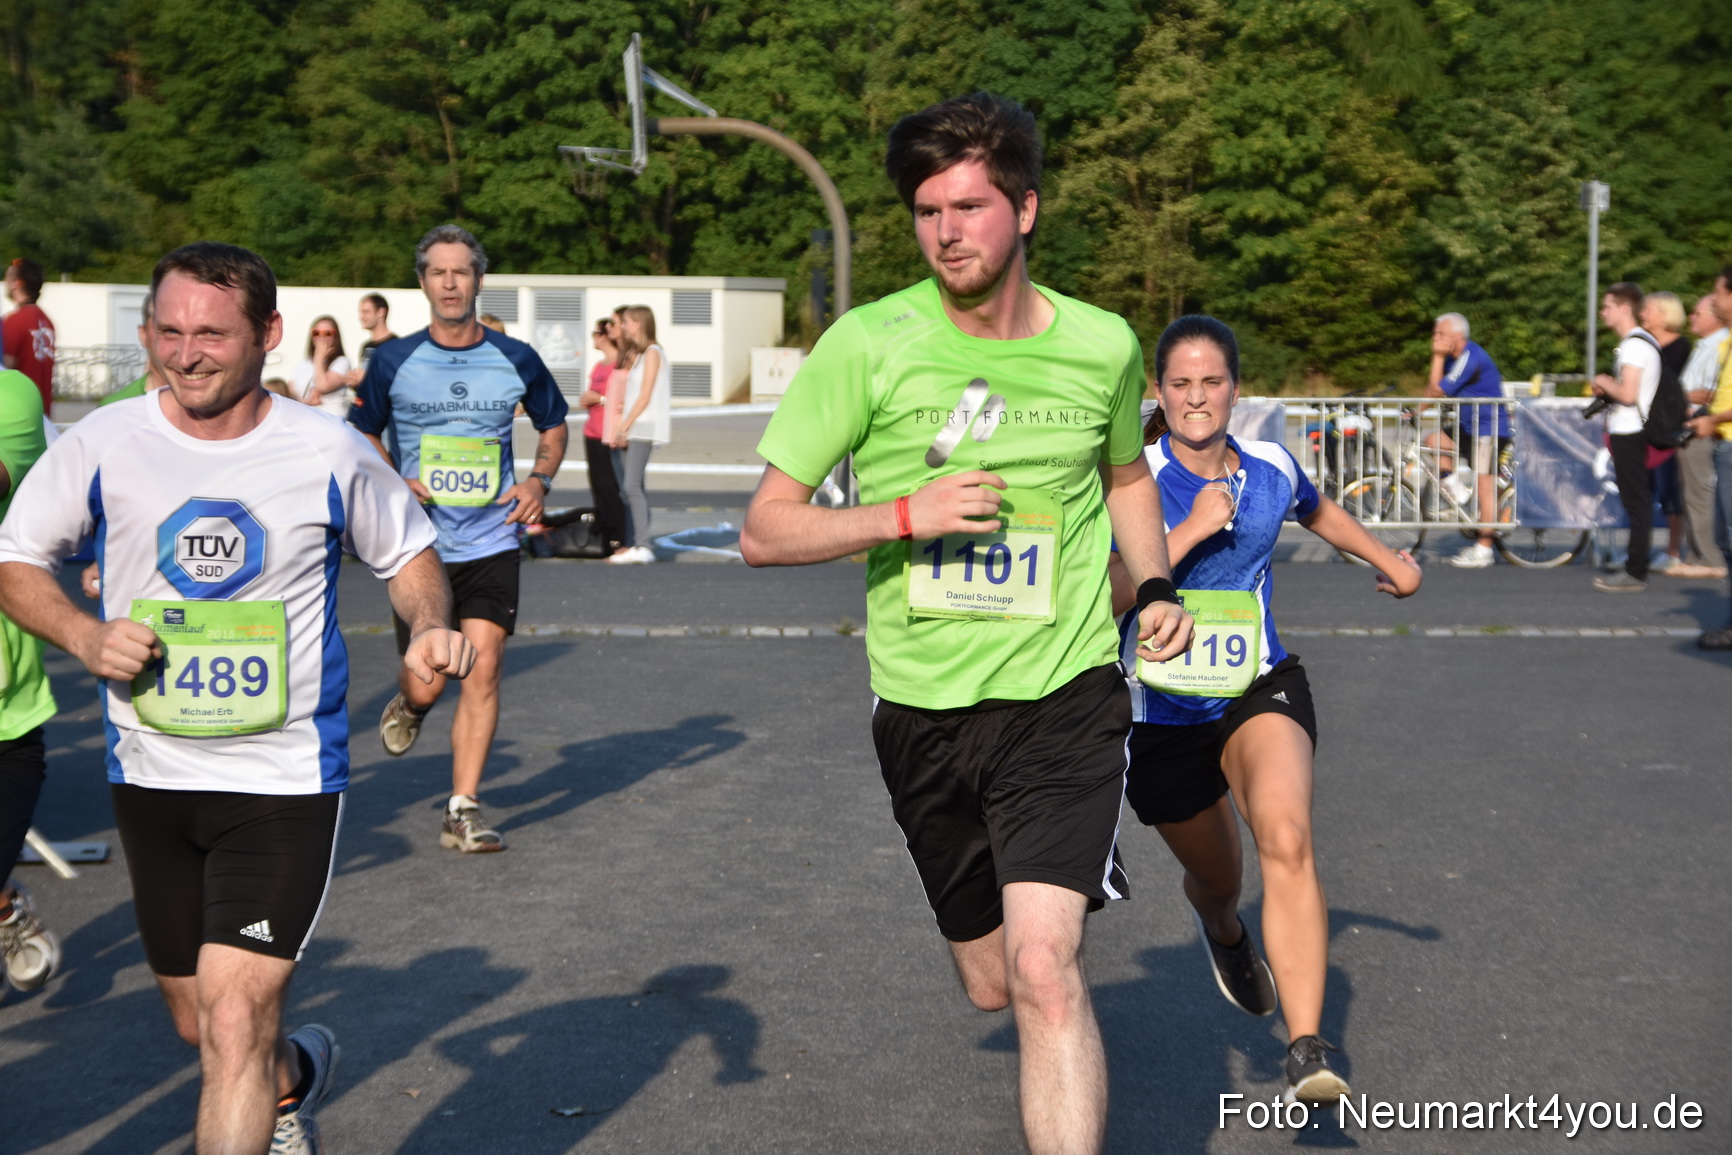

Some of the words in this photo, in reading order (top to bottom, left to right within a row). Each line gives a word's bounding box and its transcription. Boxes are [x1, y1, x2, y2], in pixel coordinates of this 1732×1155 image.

[410, 400, 508, 414] SCHABMÜLLER
[1017, 457, 1049, 468] Cloud
[429, 468, 490, 493] 6094
[182, 535, 240, 558] TÜV
[922, 537, 1039, 586] 1101
[195, 564, 223, 577] SÜD
[945, 590, 976, 602] Daniel
[976, 593, 1014, 604] Schlupp
[950, 602, 992, 611] PORTFORMANCE
[152, 622, 206, 634] firmenlauf
[206, 629, 236, 640] 2015
[146, 655, 269, 698] 1489
[1167, 672, 1197, 681] Stefanie
[1197, 674, 1229, 682] Haubner
[180, 708, 215, 716] Michael
[217, 707, 234, 716] Erb
[239, 927, 274, 942] adidas
